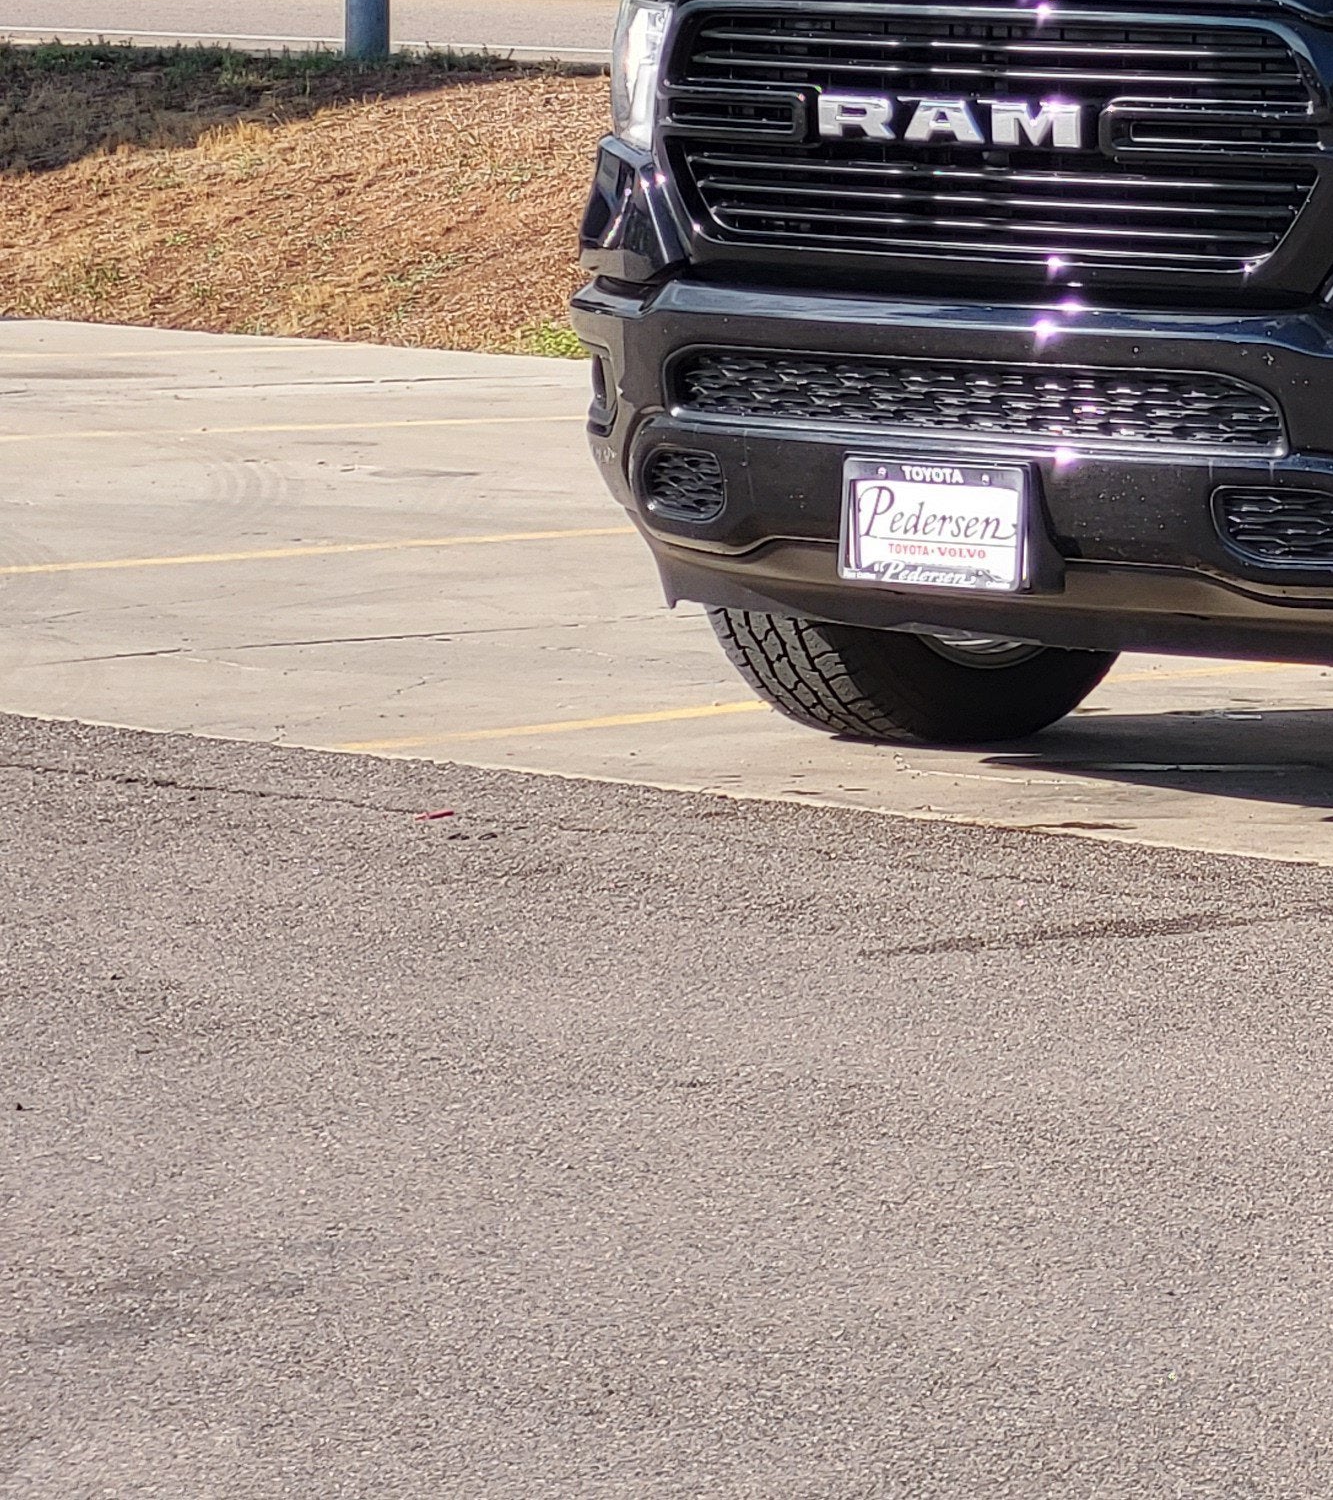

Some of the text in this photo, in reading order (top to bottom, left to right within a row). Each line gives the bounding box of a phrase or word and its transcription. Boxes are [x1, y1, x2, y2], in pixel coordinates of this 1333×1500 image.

[816, 94, 1082, 148] RAM
[901, 466, 963, 484] TOYOTA
[858, 485, 1017, 540] Pedersen
[889, 543, 986, 559] TOYOTA VOLVO
[880, 560, 976, 585] Pedersen
